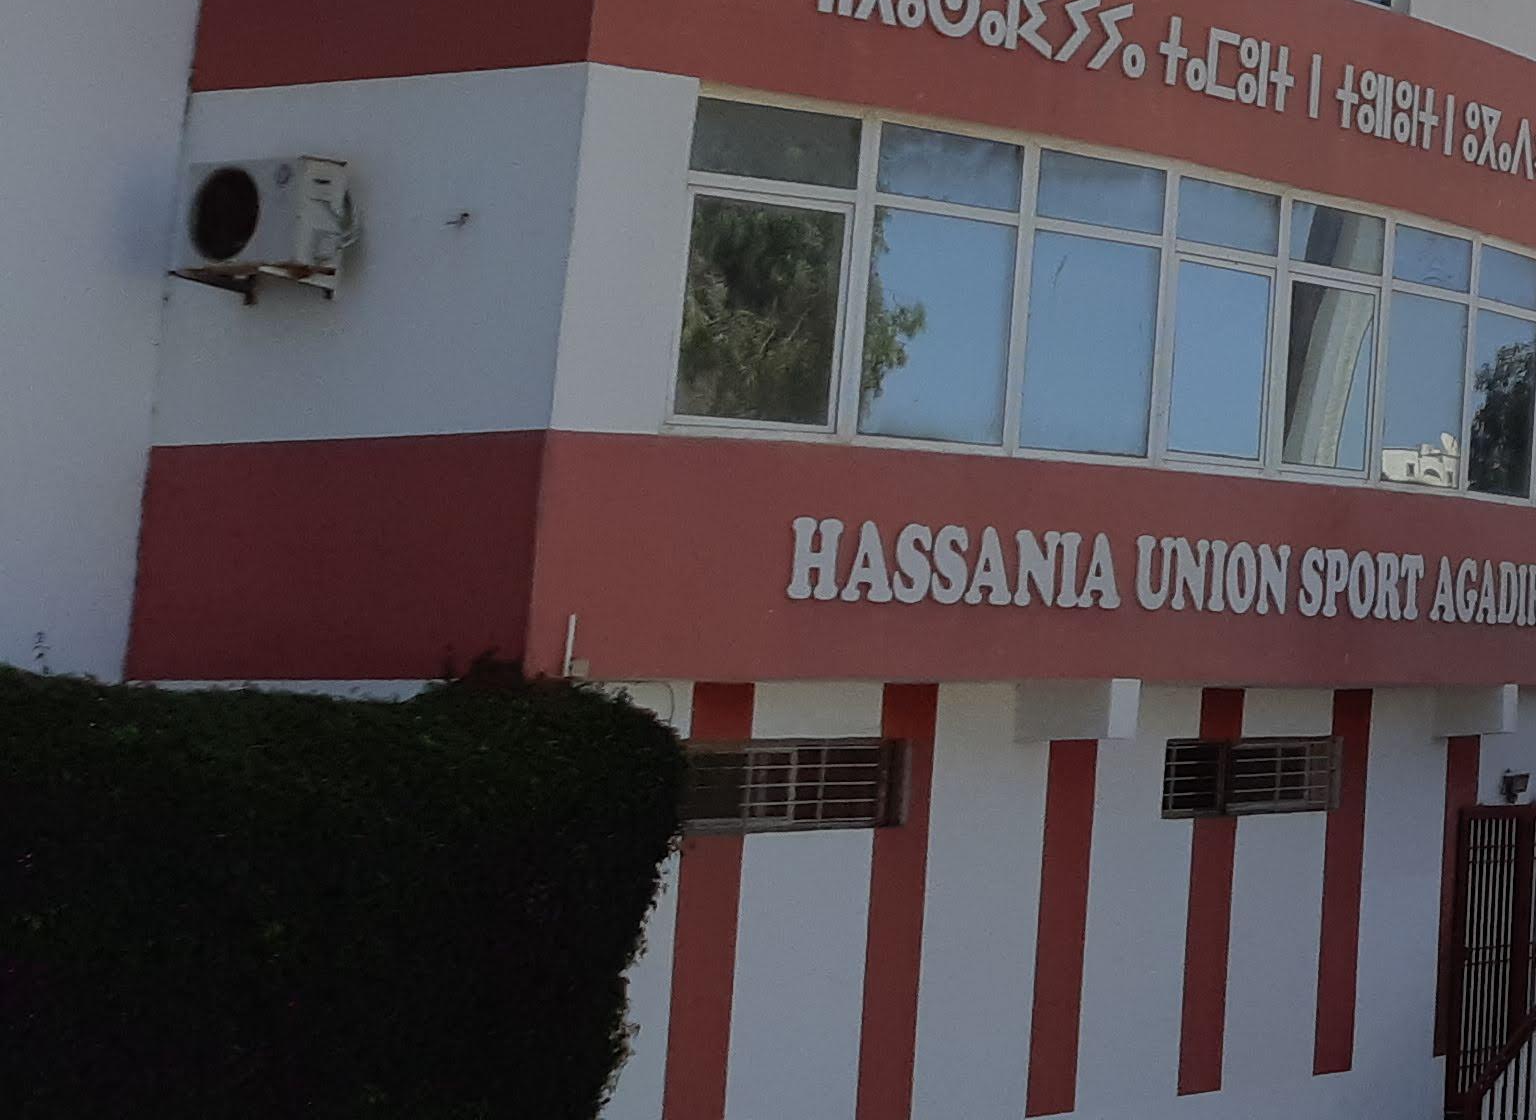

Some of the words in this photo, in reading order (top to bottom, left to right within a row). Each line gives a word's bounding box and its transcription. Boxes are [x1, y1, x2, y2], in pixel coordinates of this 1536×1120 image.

[785, 516, 1122, 610] HASSANIA
[1134, 533, 1292, 616] UNION
[1296, 546, 1425, 621] SPORT
